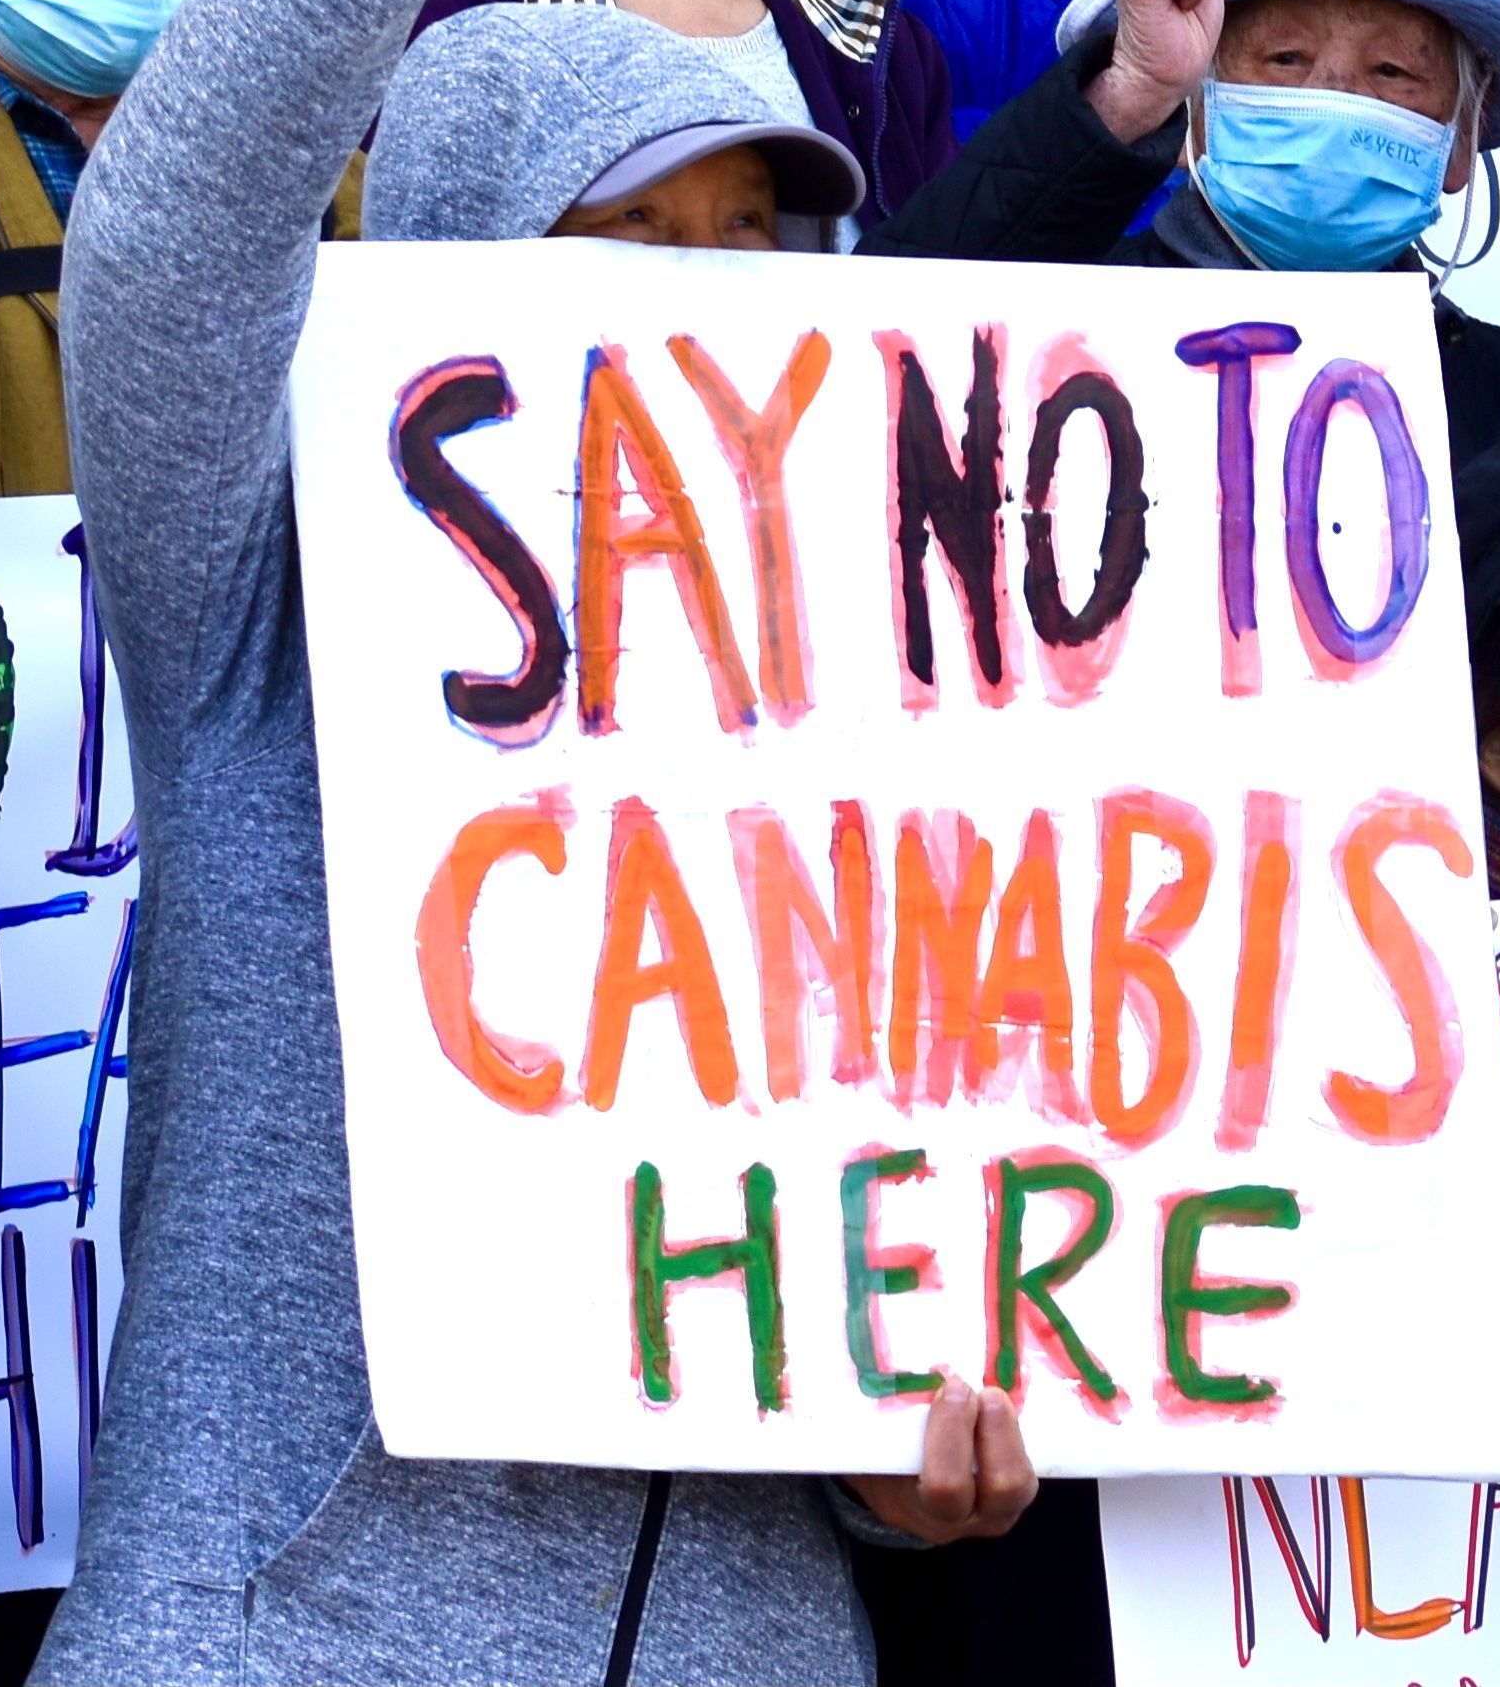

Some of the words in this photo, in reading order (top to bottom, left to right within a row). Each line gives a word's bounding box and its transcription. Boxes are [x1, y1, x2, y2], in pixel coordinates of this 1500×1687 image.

[386, 328, 832, 752] SAY
[874, 322, 1160, 720] NO
[1174, 320, 1432, 700] TO
[414, 782, 1476, 1154] CANNABIS
[625, 1144, 1312, 1420] HERE
